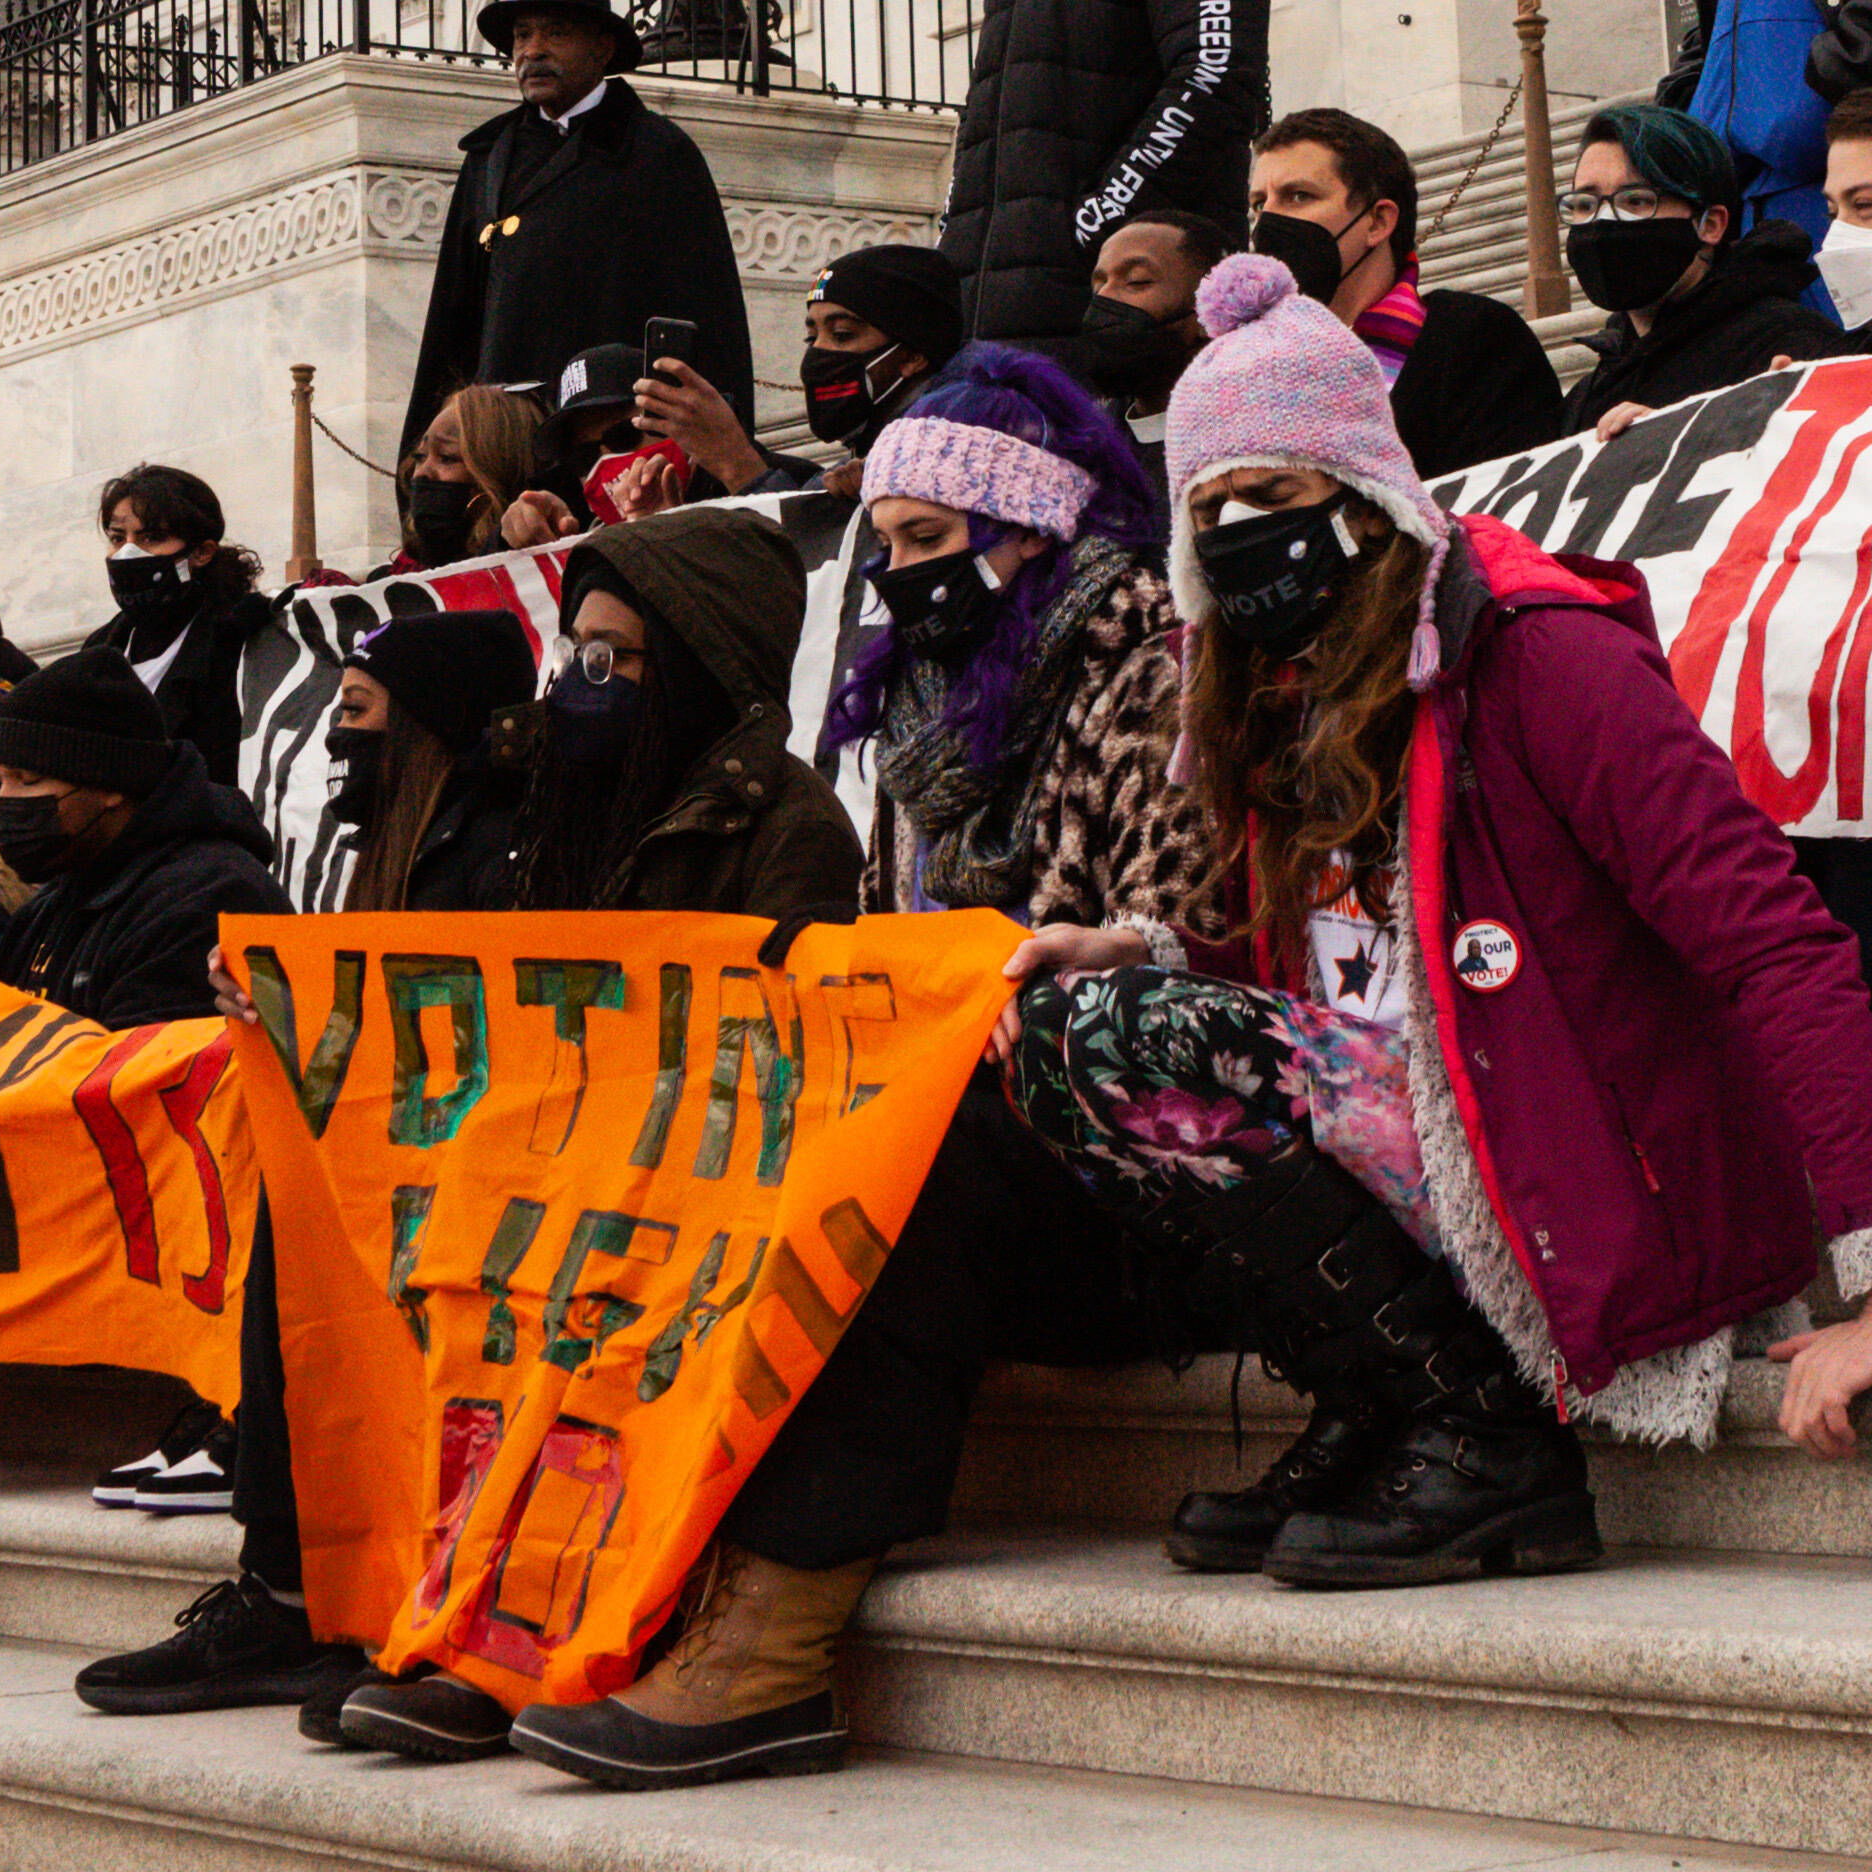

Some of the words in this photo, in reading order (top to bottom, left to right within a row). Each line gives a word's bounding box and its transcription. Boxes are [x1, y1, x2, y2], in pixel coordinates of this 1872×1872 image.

[1130, 106, 1195, 170] UNTIL
[1219, 572, 1302, 618] VOTE
[1484, 940, 1512, 955] OUR
[1465, 966, 1509, 983] VOTE!
[242, 945, 897, 1187] VOTING
